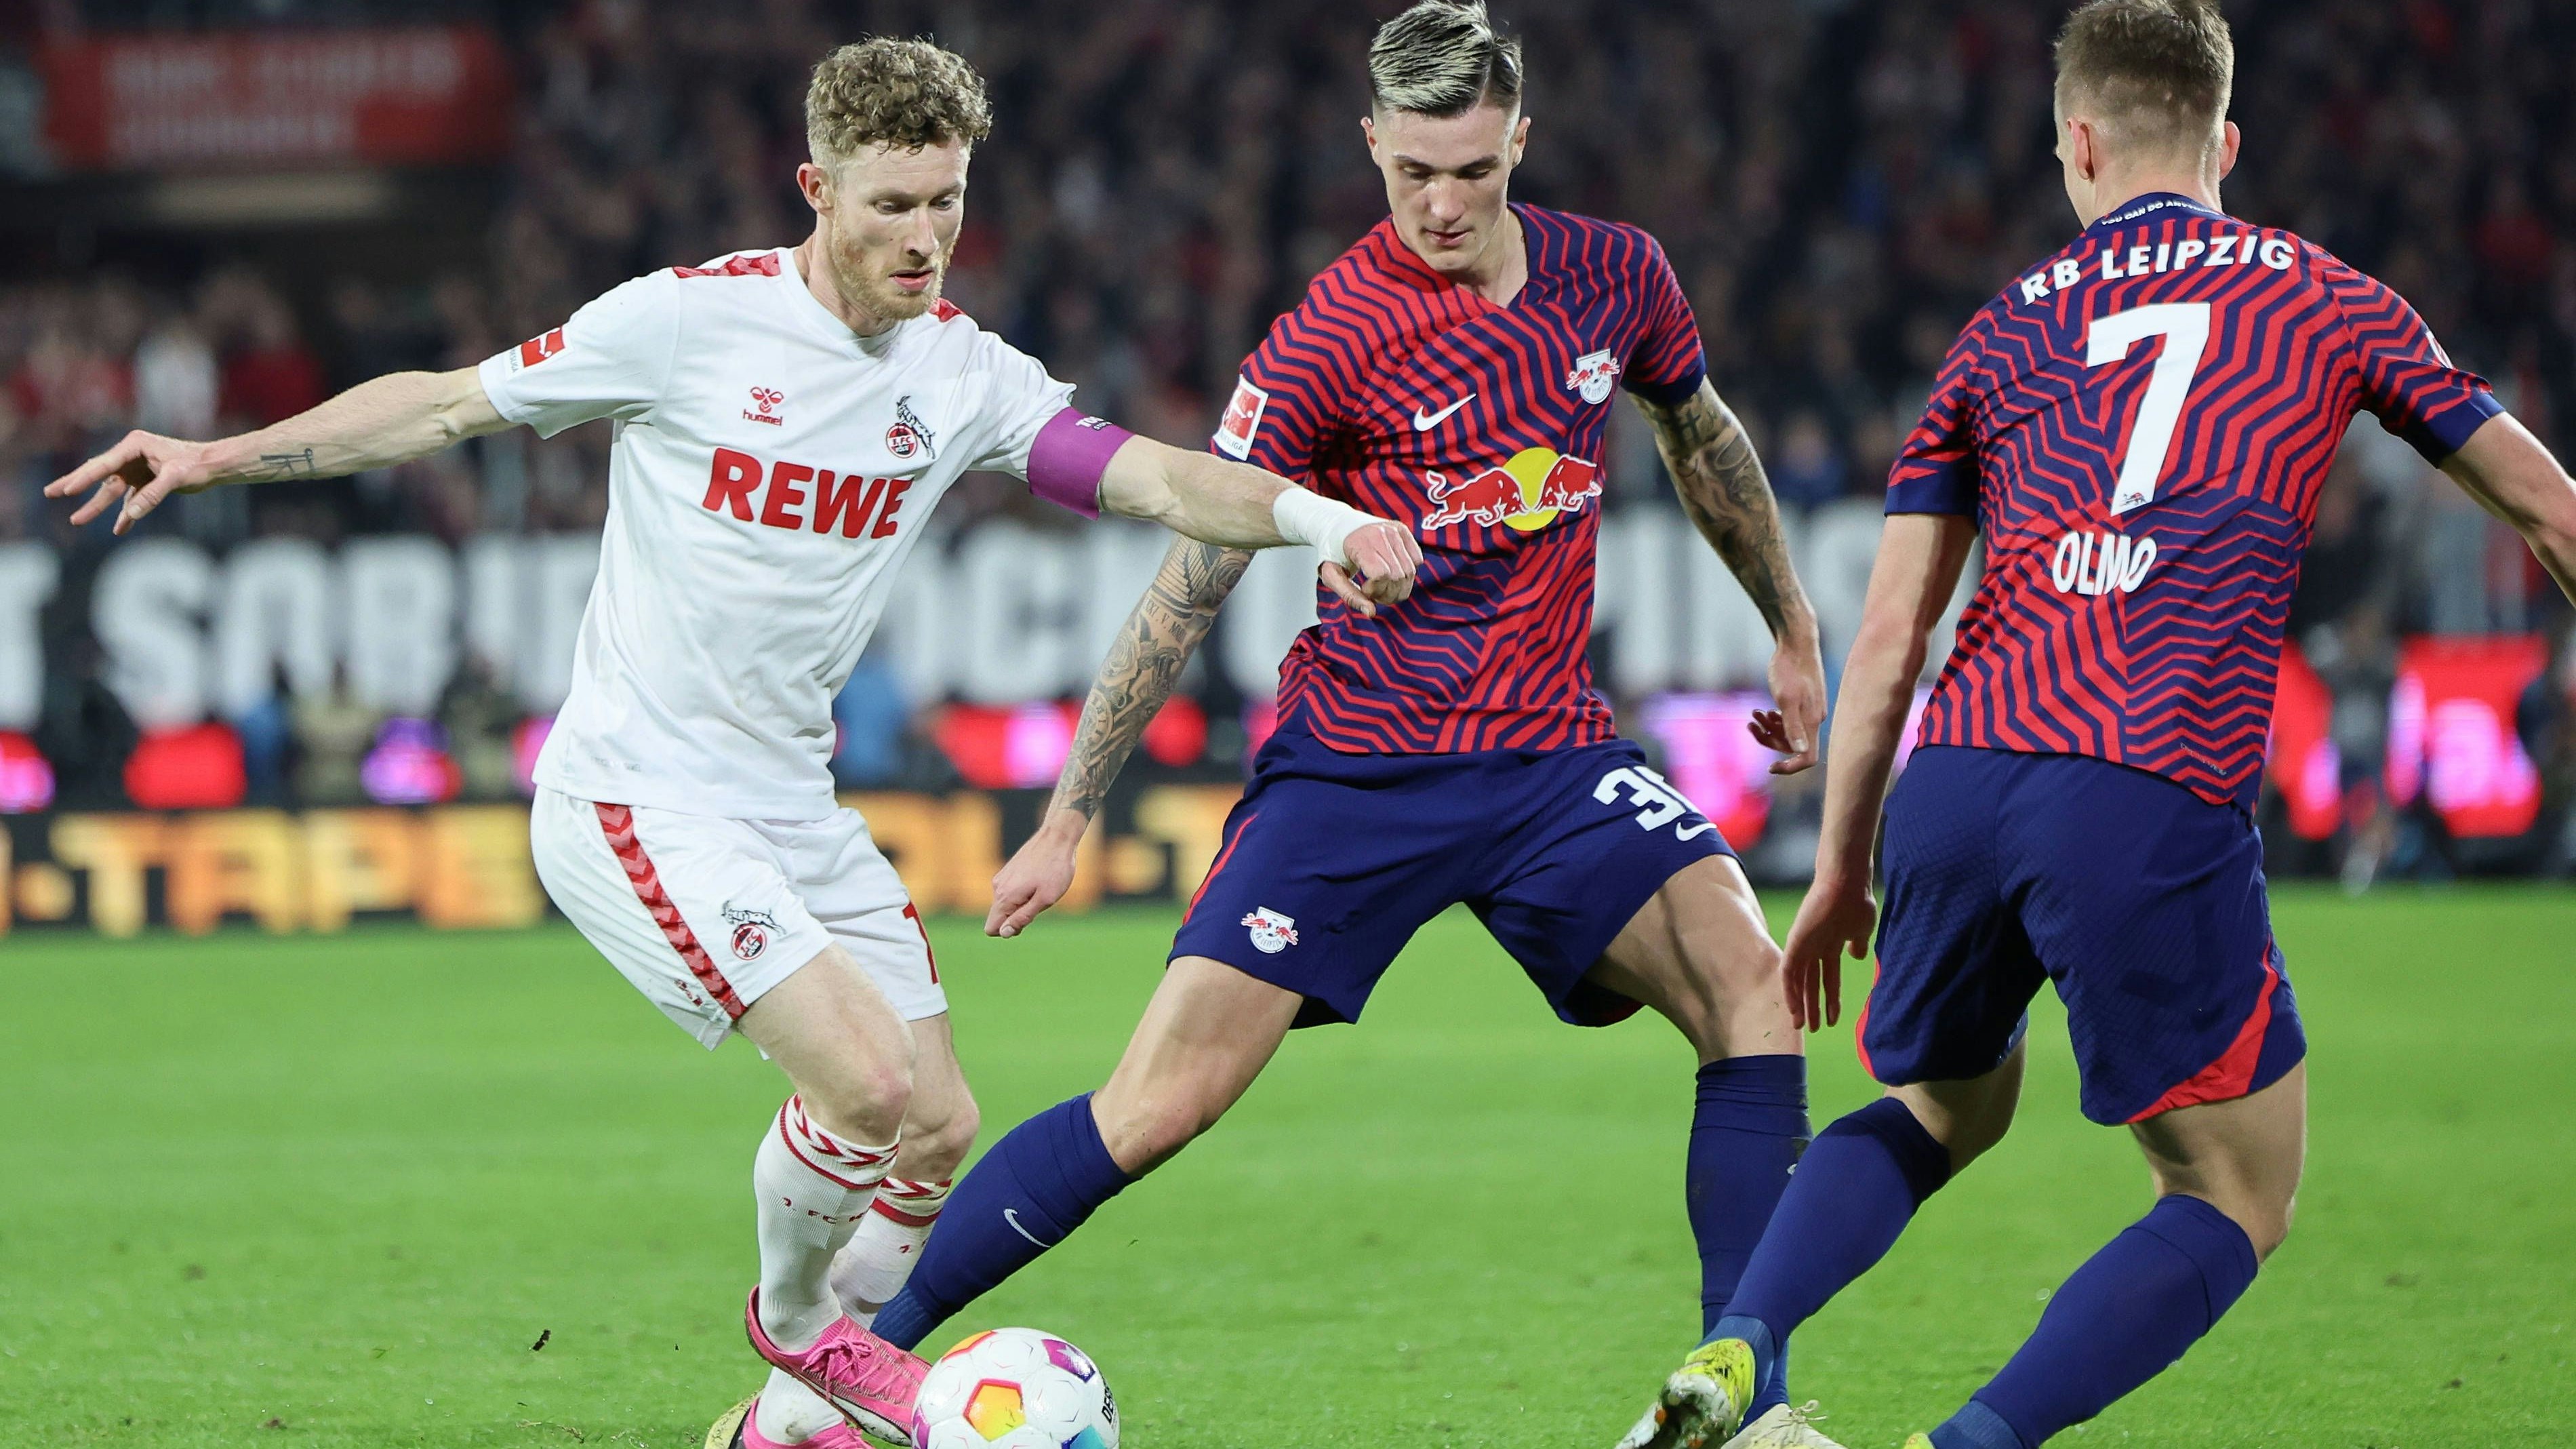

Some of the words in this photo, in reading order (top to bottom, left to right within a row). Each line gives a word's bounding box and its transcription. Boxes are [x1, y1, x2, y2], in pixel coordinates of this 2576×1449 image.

[2101, 216, 2122, 225] YOU
[2125, 207, 2146, 220] CAN
[2148, 201, 2164, 212] DO
[2019, 258, 2080, 306] RB
[2101, 235, 2296, 280] LEIPZIG
[743, 409, 782, 426] hummel
[2086, 302, 2211, 516] 7
[702, 448, 913, 539] REWE
[2052, 532, 2158, 596] OLMO
[1593, 766, 1700, 832] 3
